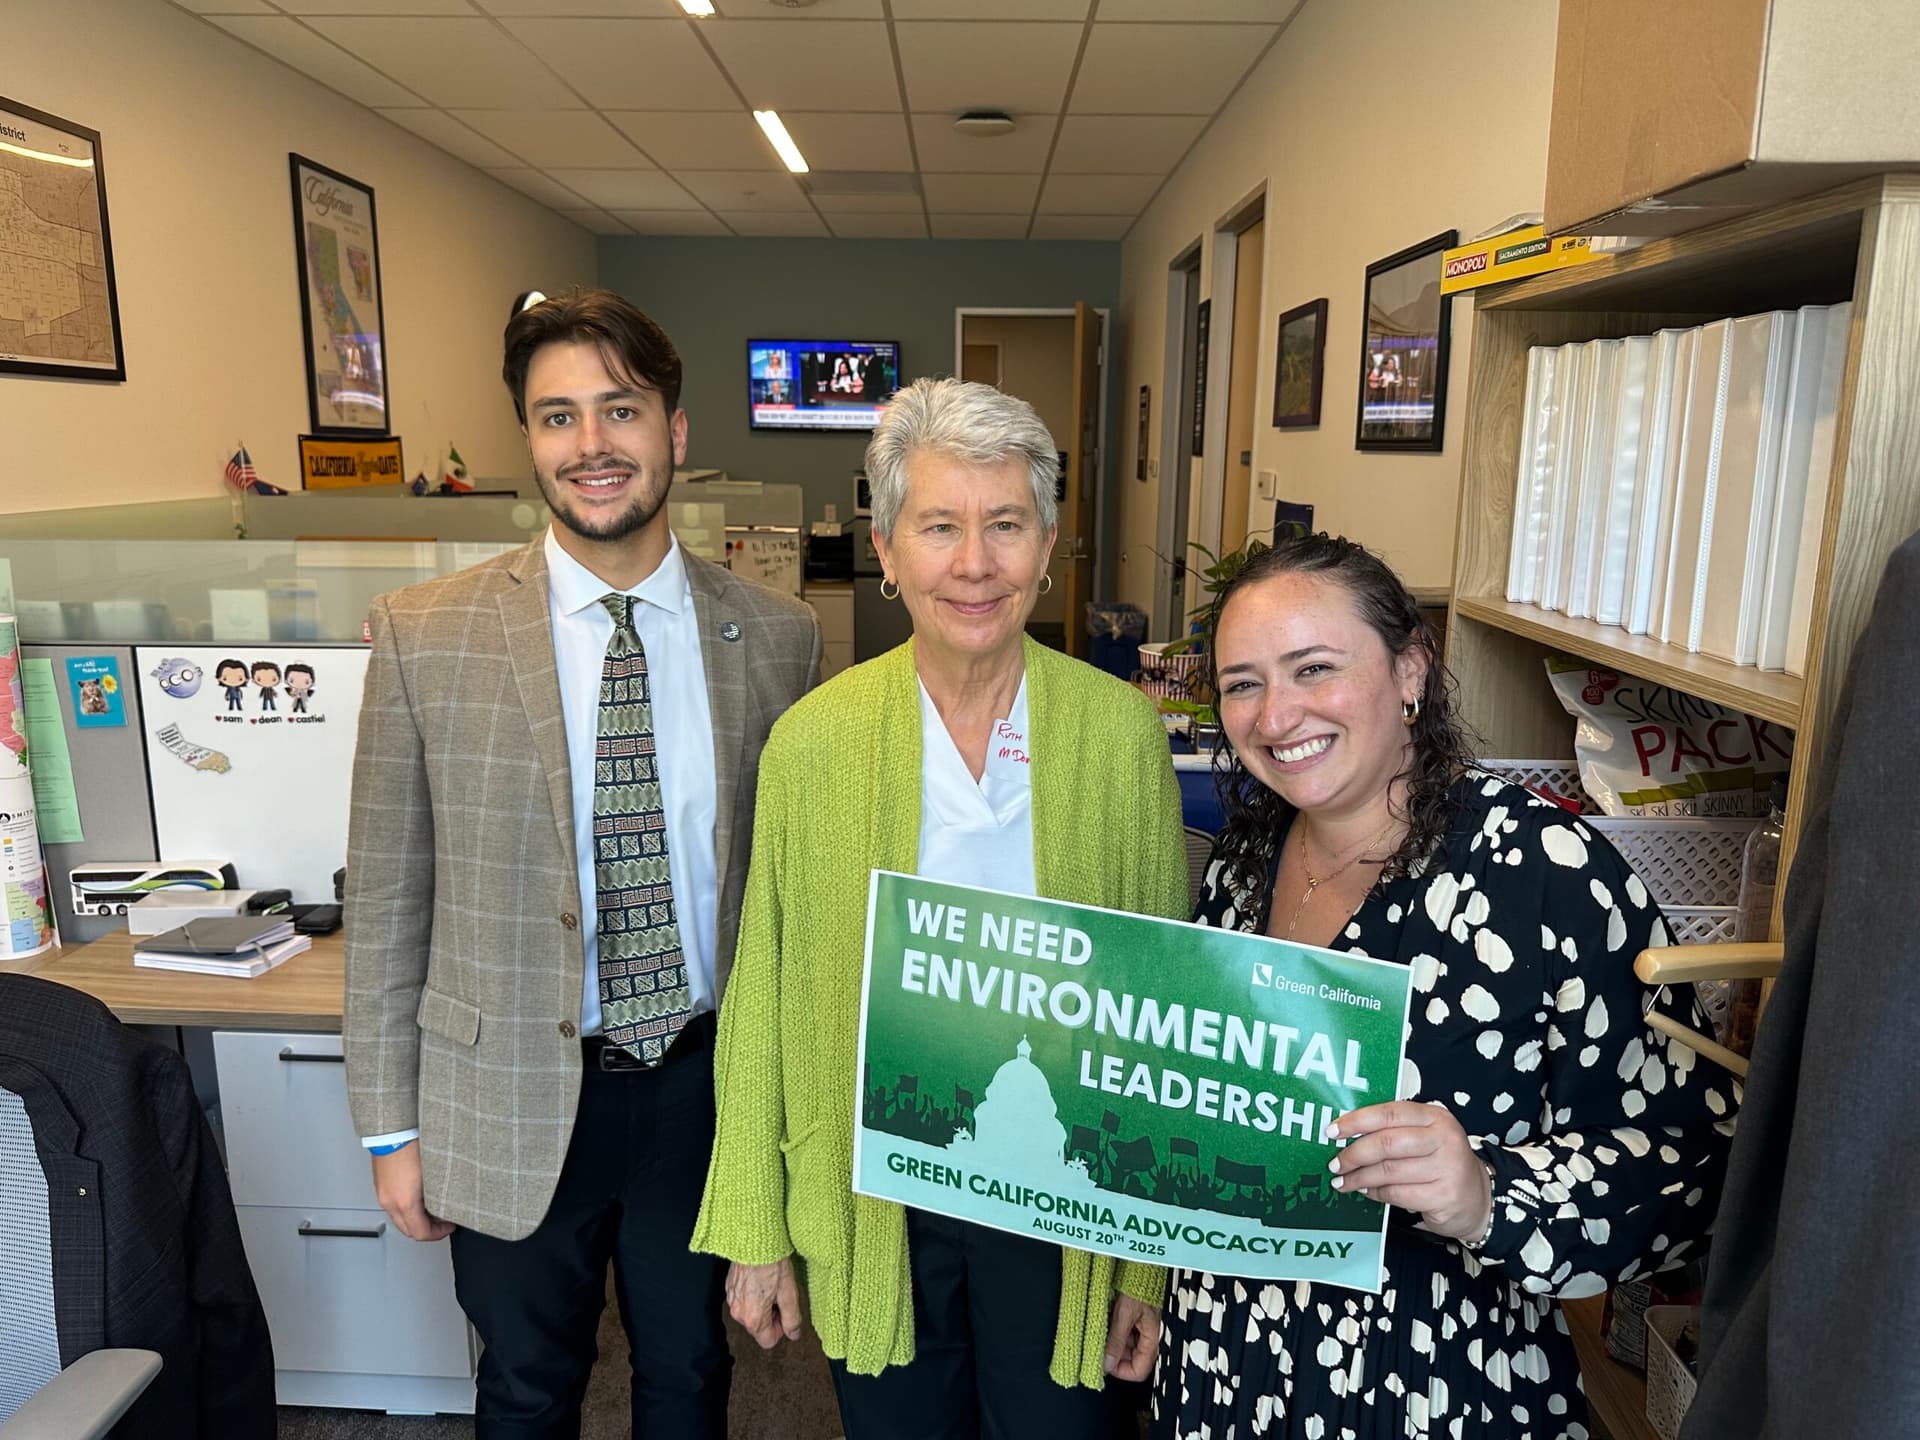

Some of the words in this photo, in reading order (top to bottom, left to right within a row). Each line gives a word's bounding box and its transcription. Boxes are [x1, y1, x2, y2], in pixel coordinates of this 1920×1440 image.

[0, 122, 26, 142] istrict
[304, 176, 353, 216] California
[1446, 252, 1488, 277] MONOPOLY
[1499, 248, 1528, 261] SACRAMENTO
[1528, 241, 1547, 254] EDITION
[309, 455, 357, 477] CALIFORNIA
[1591, 670, 1600, 685] 6
[223, 715, 243, 723] sam
[258, 715, 282, 724] dean
[295, 714, 326, 723] castiel
[1703, 793, 1746, 812] SKINNY
[907, 898, 967, 943] WE
[979, 912, 1092, 966] NEED
[1275, 975, 1315, 996] Green
[1319, 984, 1382, 1011] California
[901, 948, 1369, 1093] ENVIRONMENTAL
[887, 1152, 962, 1189] GREEN
[968, 1174, 1118, 1229] CALIFORNIA
[1123, 1214, 1288, 1255] ADVOCACY
[1294, 1240, 1354, 1259] DAY
[1032, 1217, 1092, 1240] AUGUST
[1095, 1231, 1125, 1245] 20TH
[1128, 1239, 1166, 1256] 2025
